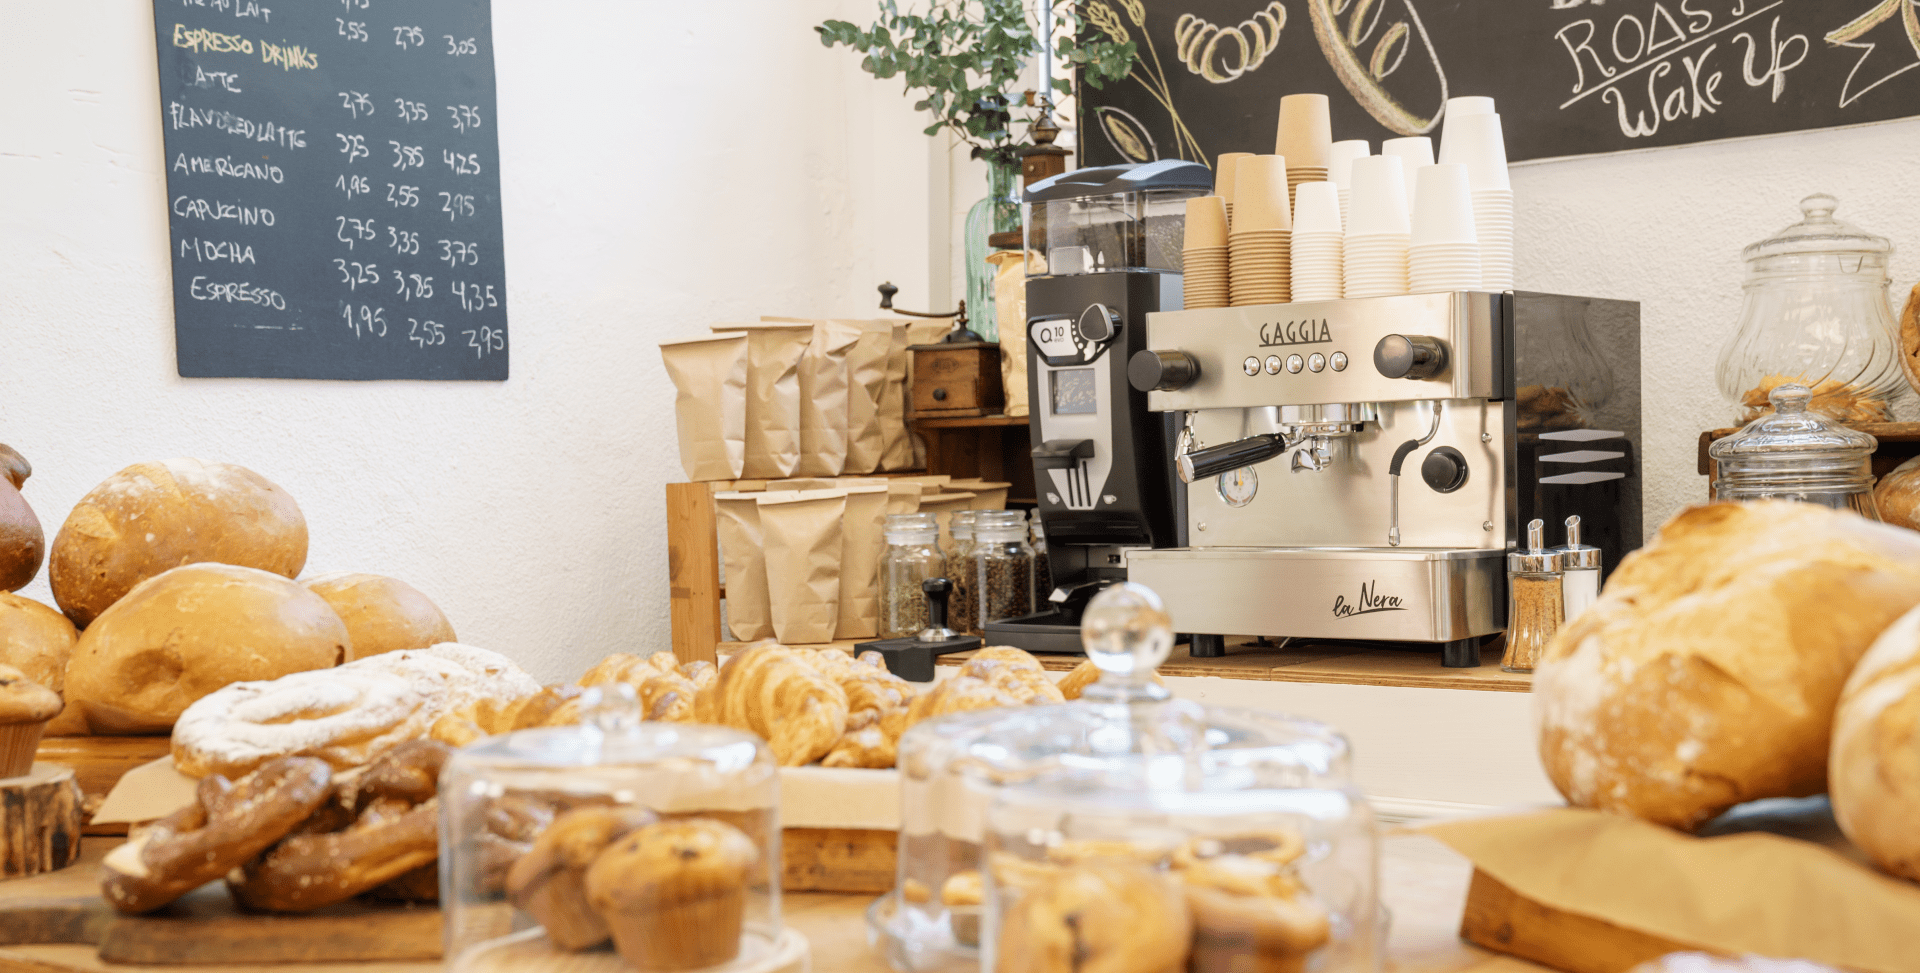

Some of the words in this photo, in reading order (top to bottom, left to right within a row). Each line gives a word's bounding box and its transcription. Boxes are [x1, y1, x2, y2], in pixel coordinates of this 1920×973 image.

[173, 23, 254, 54] ESPRESSO
[335, 17, 369, 43] 2,55
[393, 25, 425, 50] 2,75
[443, 34, 477, 57] 3,05
[182, 64, 242, 93] ATTE
[338, 89, 375, 120] 2,75
[394, 97, 429, 124] 3,35
[446, 104, 482, 135] 3,75
[388, 140, 425, 172] 3,85
[443, 148, 481, 176] 4,25
[335, 174, 371, 201] 1,95
[386, 182, 420, 208] 2,55
[438, 191, 476, 223] 2,95
[335, 215, 377, 251] 2,75
[387, 225, 420, 255] 3,35
[437, 239, 480, 269] 3,75
[180, 236, 256, 266] MOCHA
[333, 258, 380, 292] 3,25
[392, 269, 434, 302] 3,85
[452, 280, 498, 313] 4,35
[190, 275, 286, 311] ESPRESSO
[342, 303, 388, 340] 1,95
[408, 317, 446, 349] 2,55
[462, 325, 504, 361] 2,95
[1054, 326, 1065, 337] 10
[1258, 317, 1333, 348] GAGGIA
[1332, 594, 1355, 618] la
[1358, 579, 1403, 612] Nera
